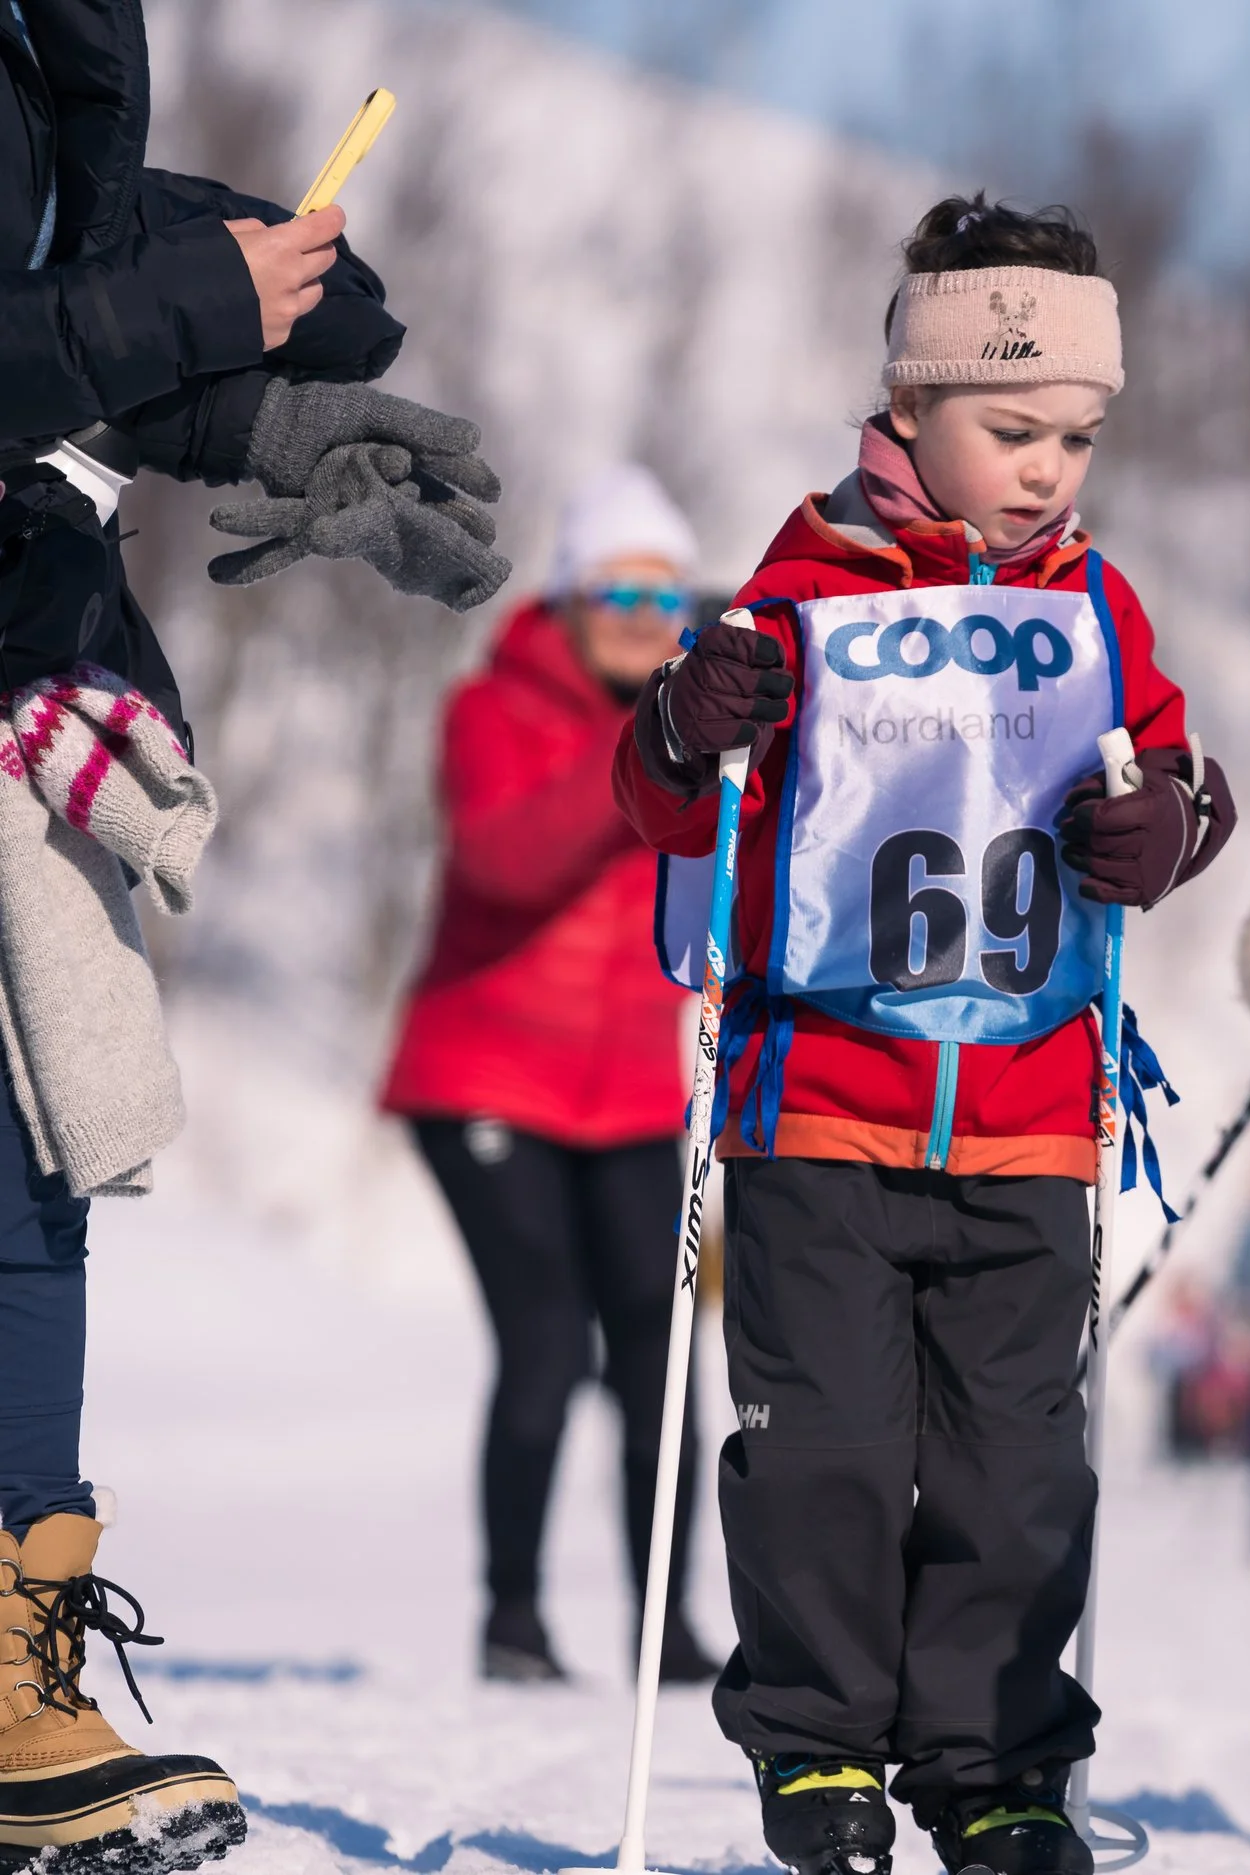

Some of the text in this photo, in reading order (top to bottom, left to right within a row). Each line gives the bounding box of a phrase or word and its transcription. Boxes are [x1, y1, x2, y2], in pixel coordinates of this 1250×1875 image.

[825, 614, 1073, 691] coop
[838, 706, 1035, 747] Nordland
[726, 828, 737, 880] FROST
[869, 826, 1063, 996] 69
